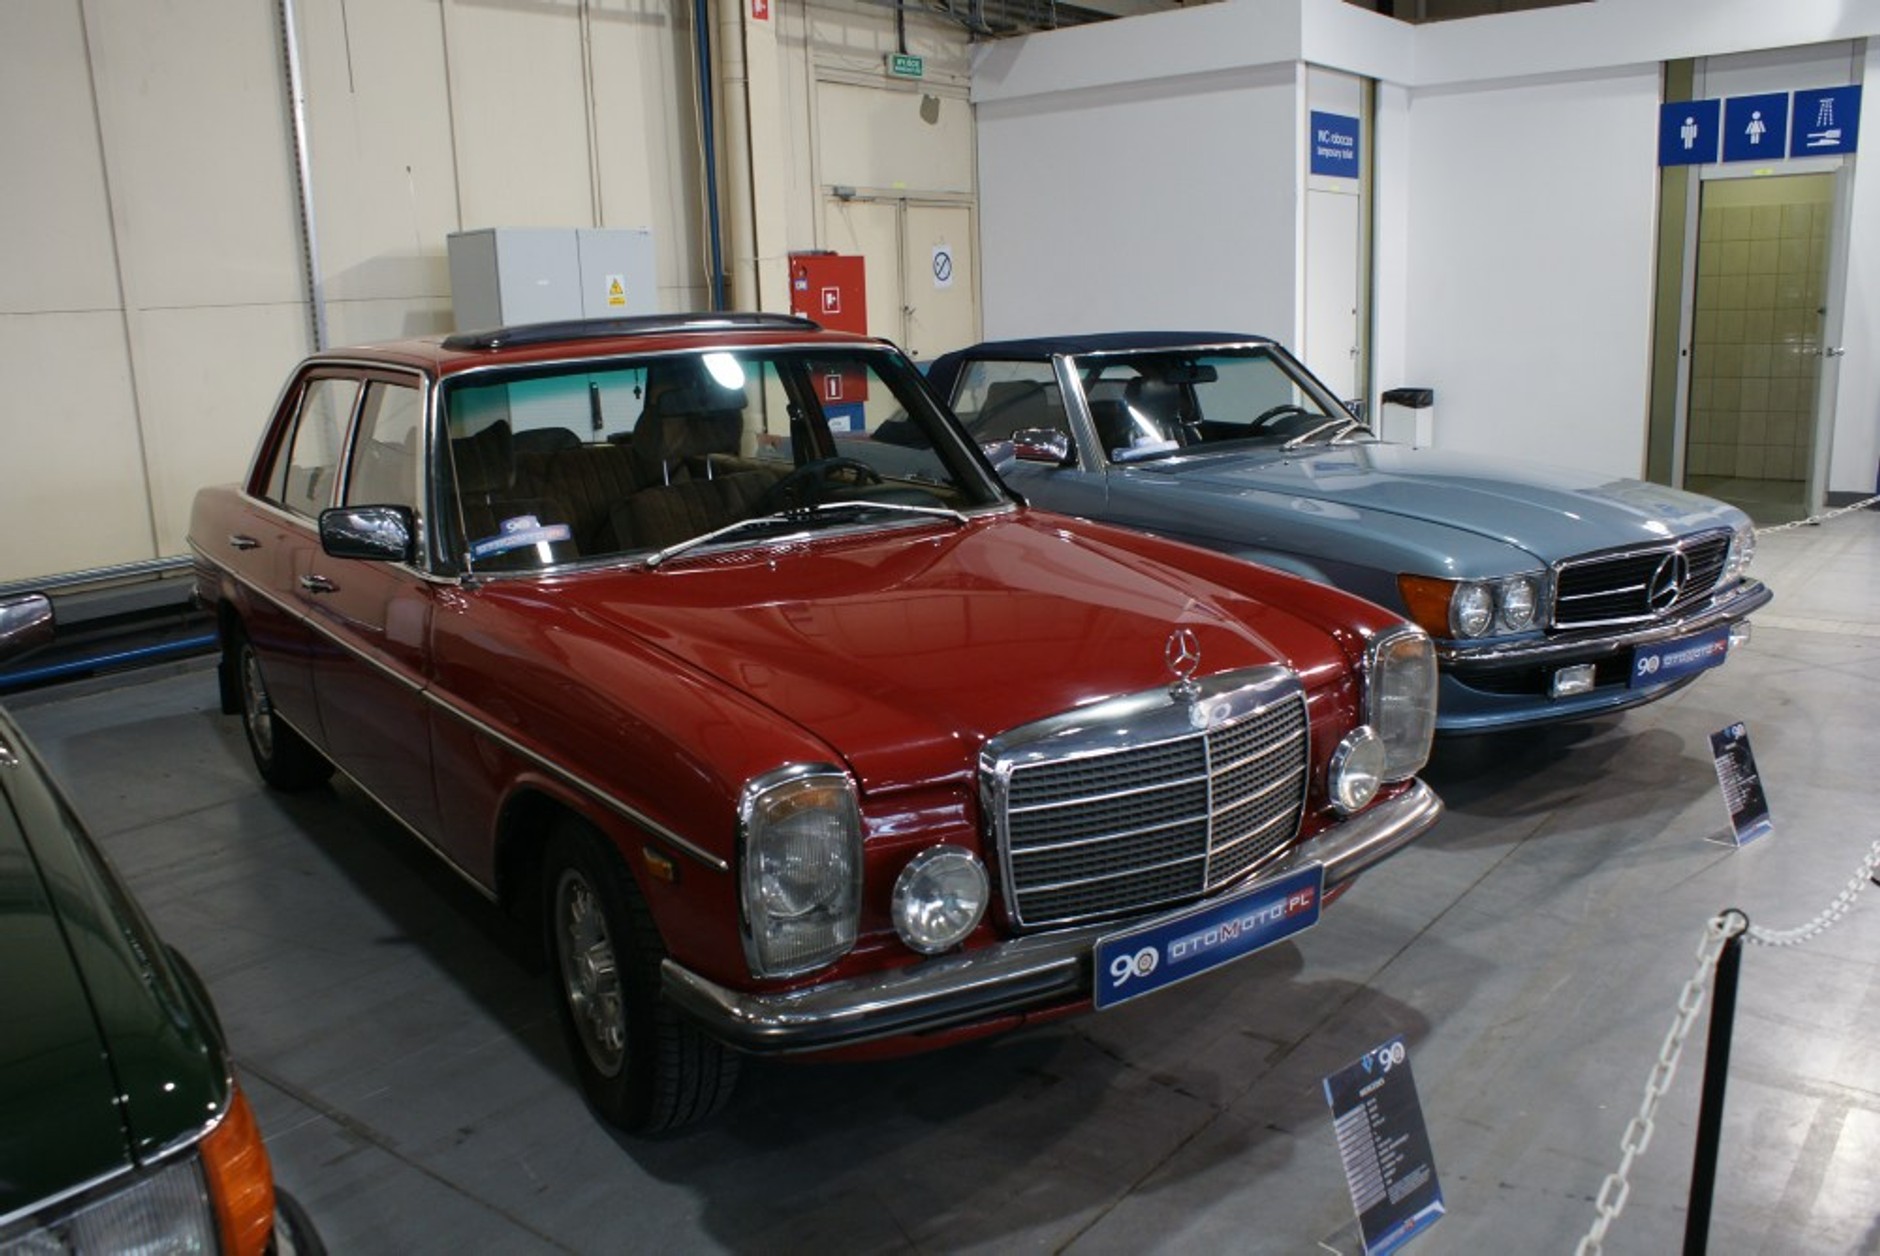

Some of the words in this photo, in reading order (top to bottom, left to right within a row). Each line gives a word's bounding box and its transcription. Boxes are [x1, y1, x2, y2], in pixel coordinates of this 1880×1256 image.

[1637, 655, 1660, 676] 90
[1110, 946, 1160, 987] 90
[1378, 1041, 1406, 1073] 90
